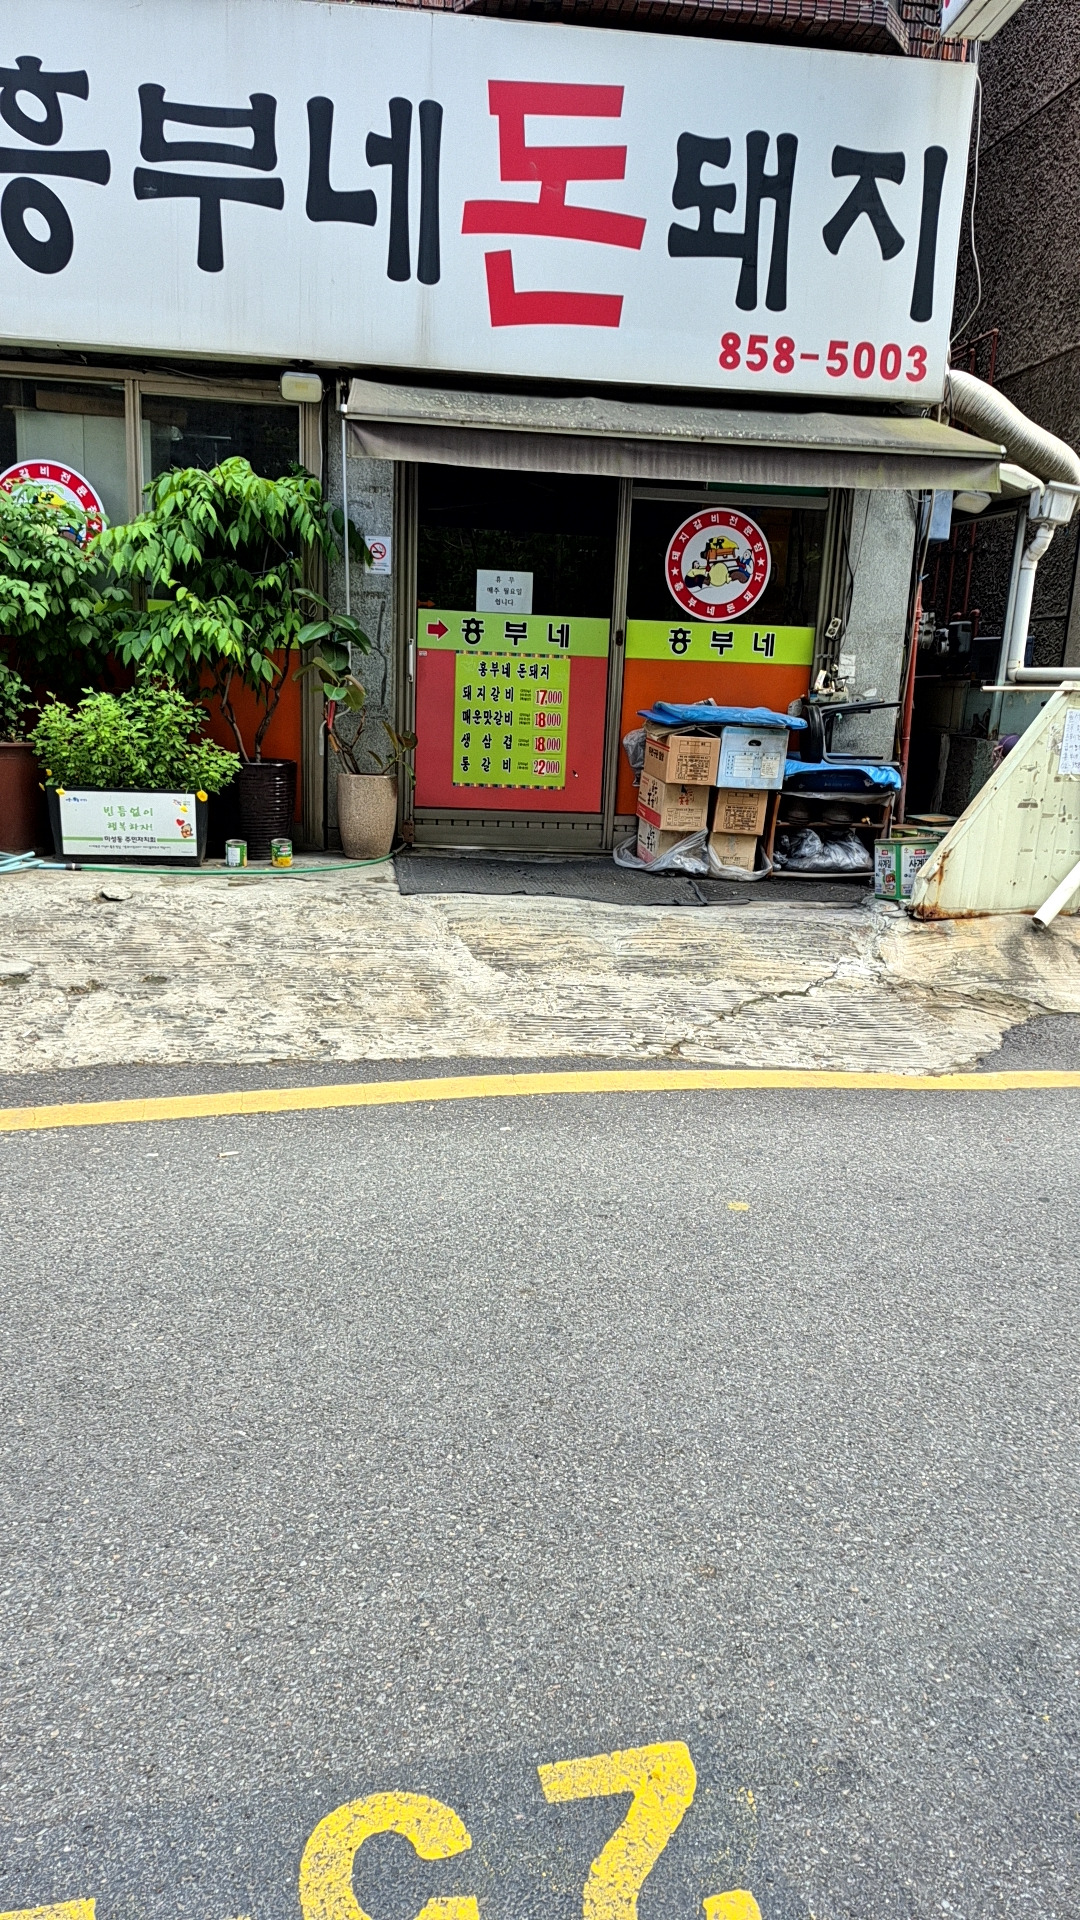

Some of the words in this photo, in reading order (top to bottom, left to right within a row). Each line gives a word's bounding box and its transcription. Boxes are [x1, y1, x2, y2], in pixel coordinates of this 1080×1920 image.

[718, 331, 928, 382] 858-5003
[517, 663, 549, 680] 돈돼지
[535, 689, 563, 706] 17,000
[462, 708, 513, 726] 매운맛갈비
